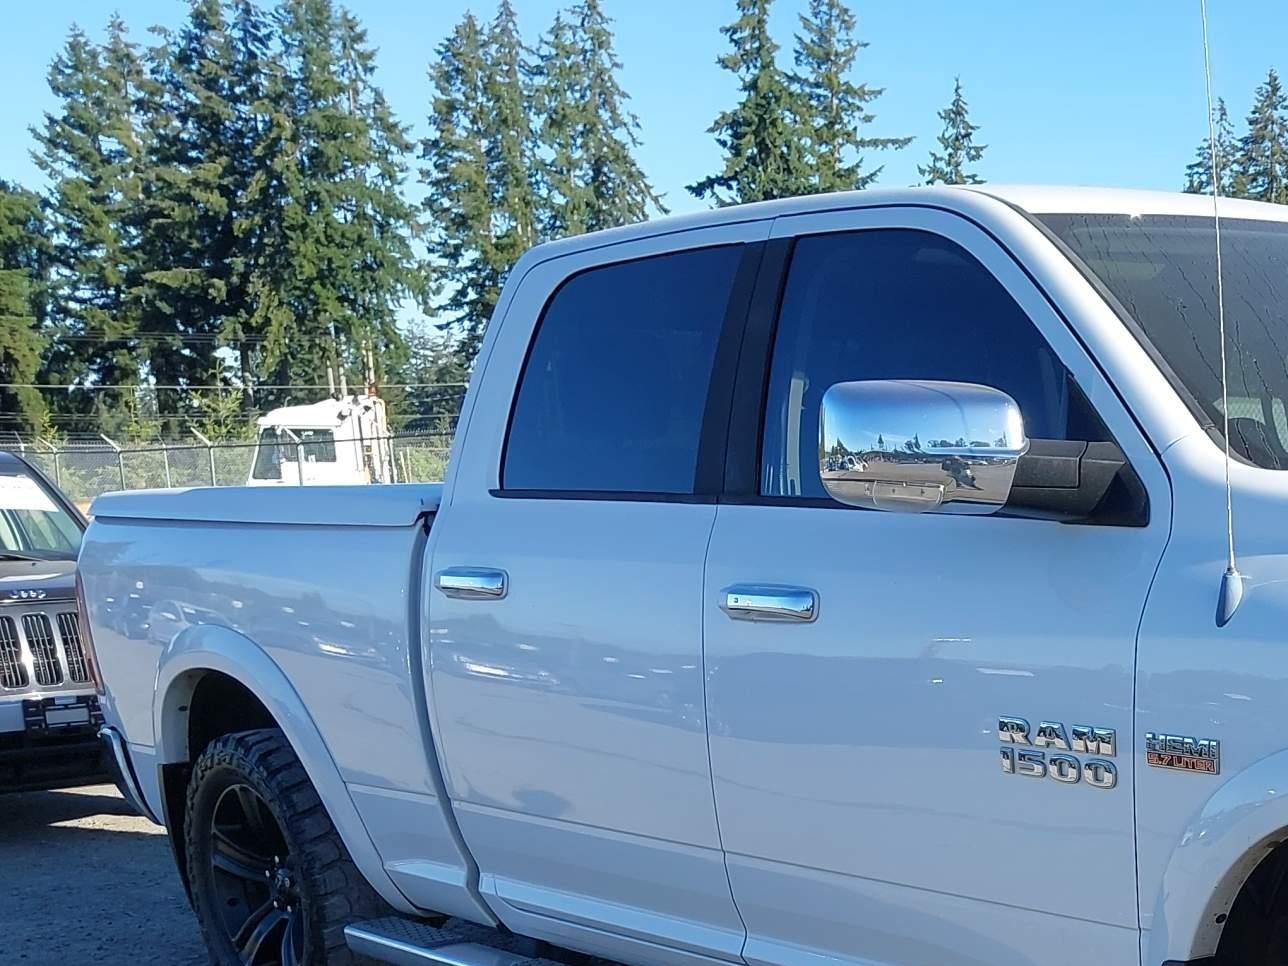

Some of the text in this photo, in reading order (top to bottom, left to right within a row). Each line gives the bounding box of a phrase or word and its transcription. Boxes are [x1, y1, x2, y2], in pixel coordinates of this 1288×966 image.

[998, 715, 1117, 757] RAM
[1145, 732, 1219, 760] HEMI
[1000, 747, 1118, 789] 1500
[1148, 752, 1214, 773] 5.7 LITER
